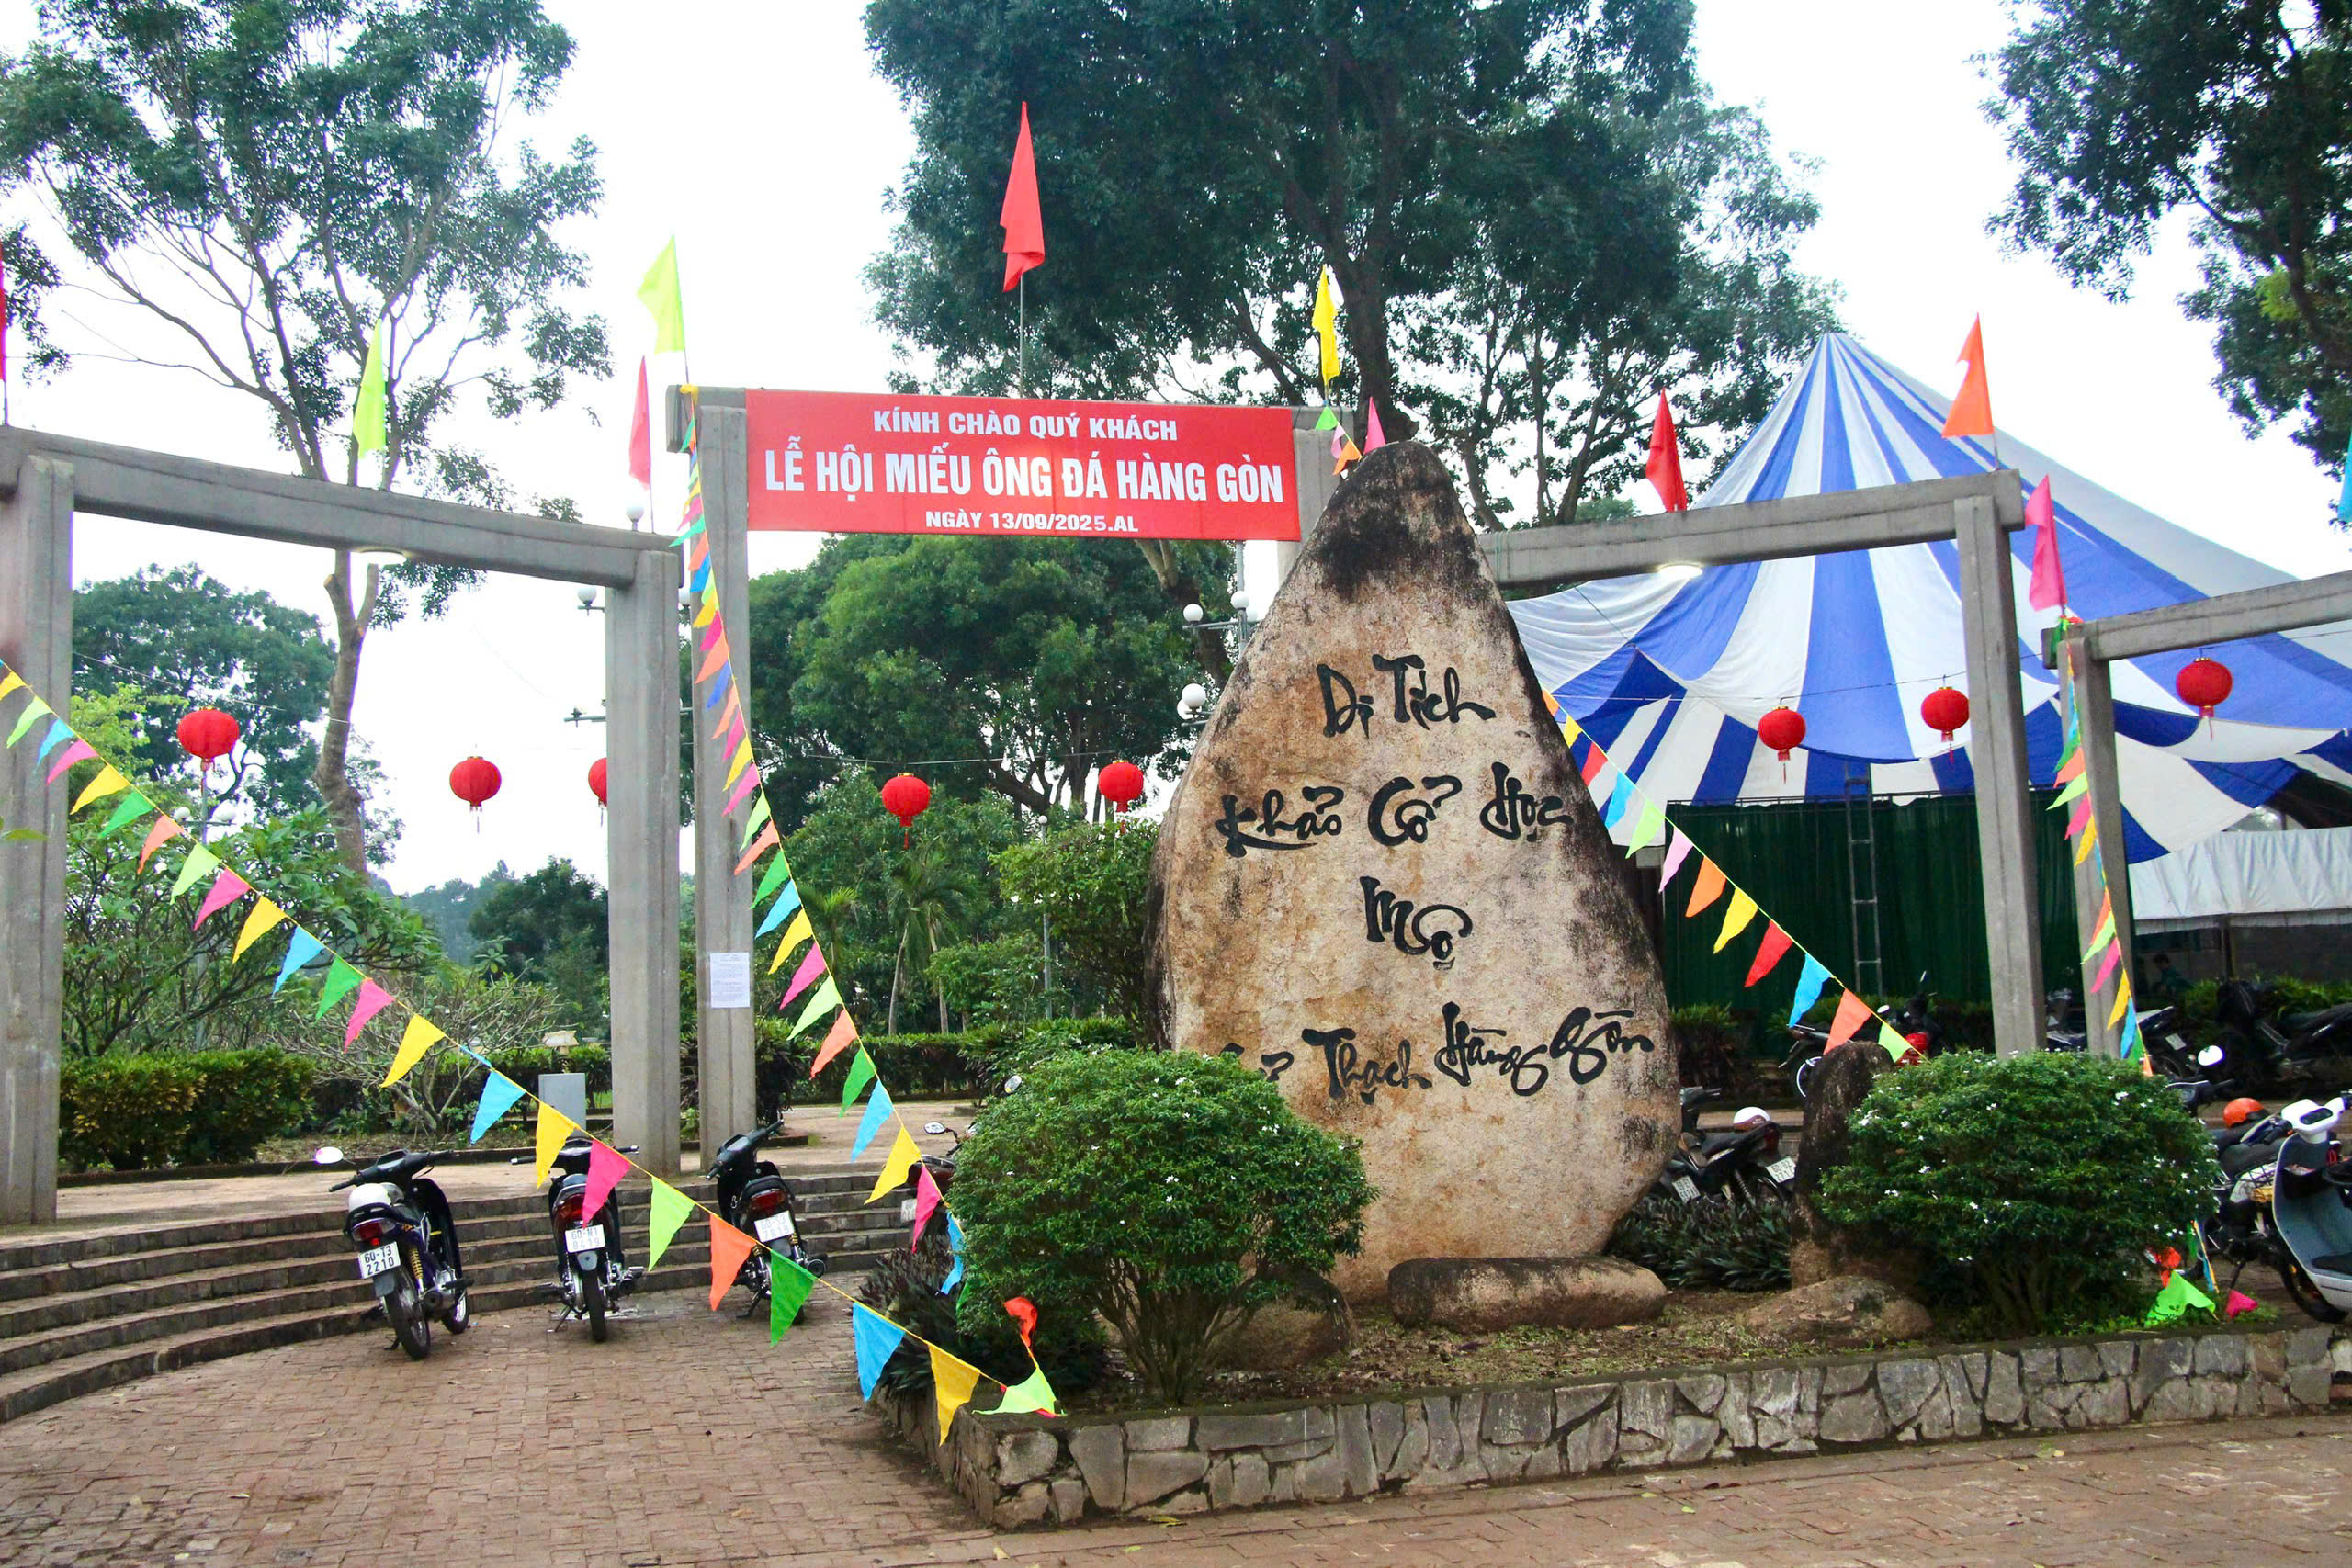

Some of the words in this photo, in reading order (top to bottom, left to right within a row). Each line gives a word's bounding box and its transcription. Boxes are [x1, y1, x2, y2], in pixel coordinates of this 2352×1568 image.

[874, 406, 940, 434] KÍNH
[949, 410, 1021, 436] CHÀO
[1030, 412, 1080, 440] QUÝ
[1090, 414, 1178, 441] KHÁCH
[764, 435, 805, 491] LỄ
[816, 443, 874, 502] HỘI
[886, 441, 972, 496] MIẾU
[983, 447, 1053, 498] ÔNG
[1060, 450, 1109, 500] ĐÁ
[1117, 453, 1207, 502] HÀNG
[1217, 454, 1283, 503] GÒN
[925, 508, 983, 530] NGÀY
[989, 512, 1140, 534] 13/09/2025.AL
[1316, 663, 1374, 739] Di
[1372, 653, 1497, 731] Tích
[1214, 785, 1345, 858] Khảo
[1367, 774, 1463, 847] Cổ
[1301, 1027, 1433, 1104] Thạch
[364, 1245, 392, 1264] 60-T3
[367, 1256, 395, 1276] 2210
